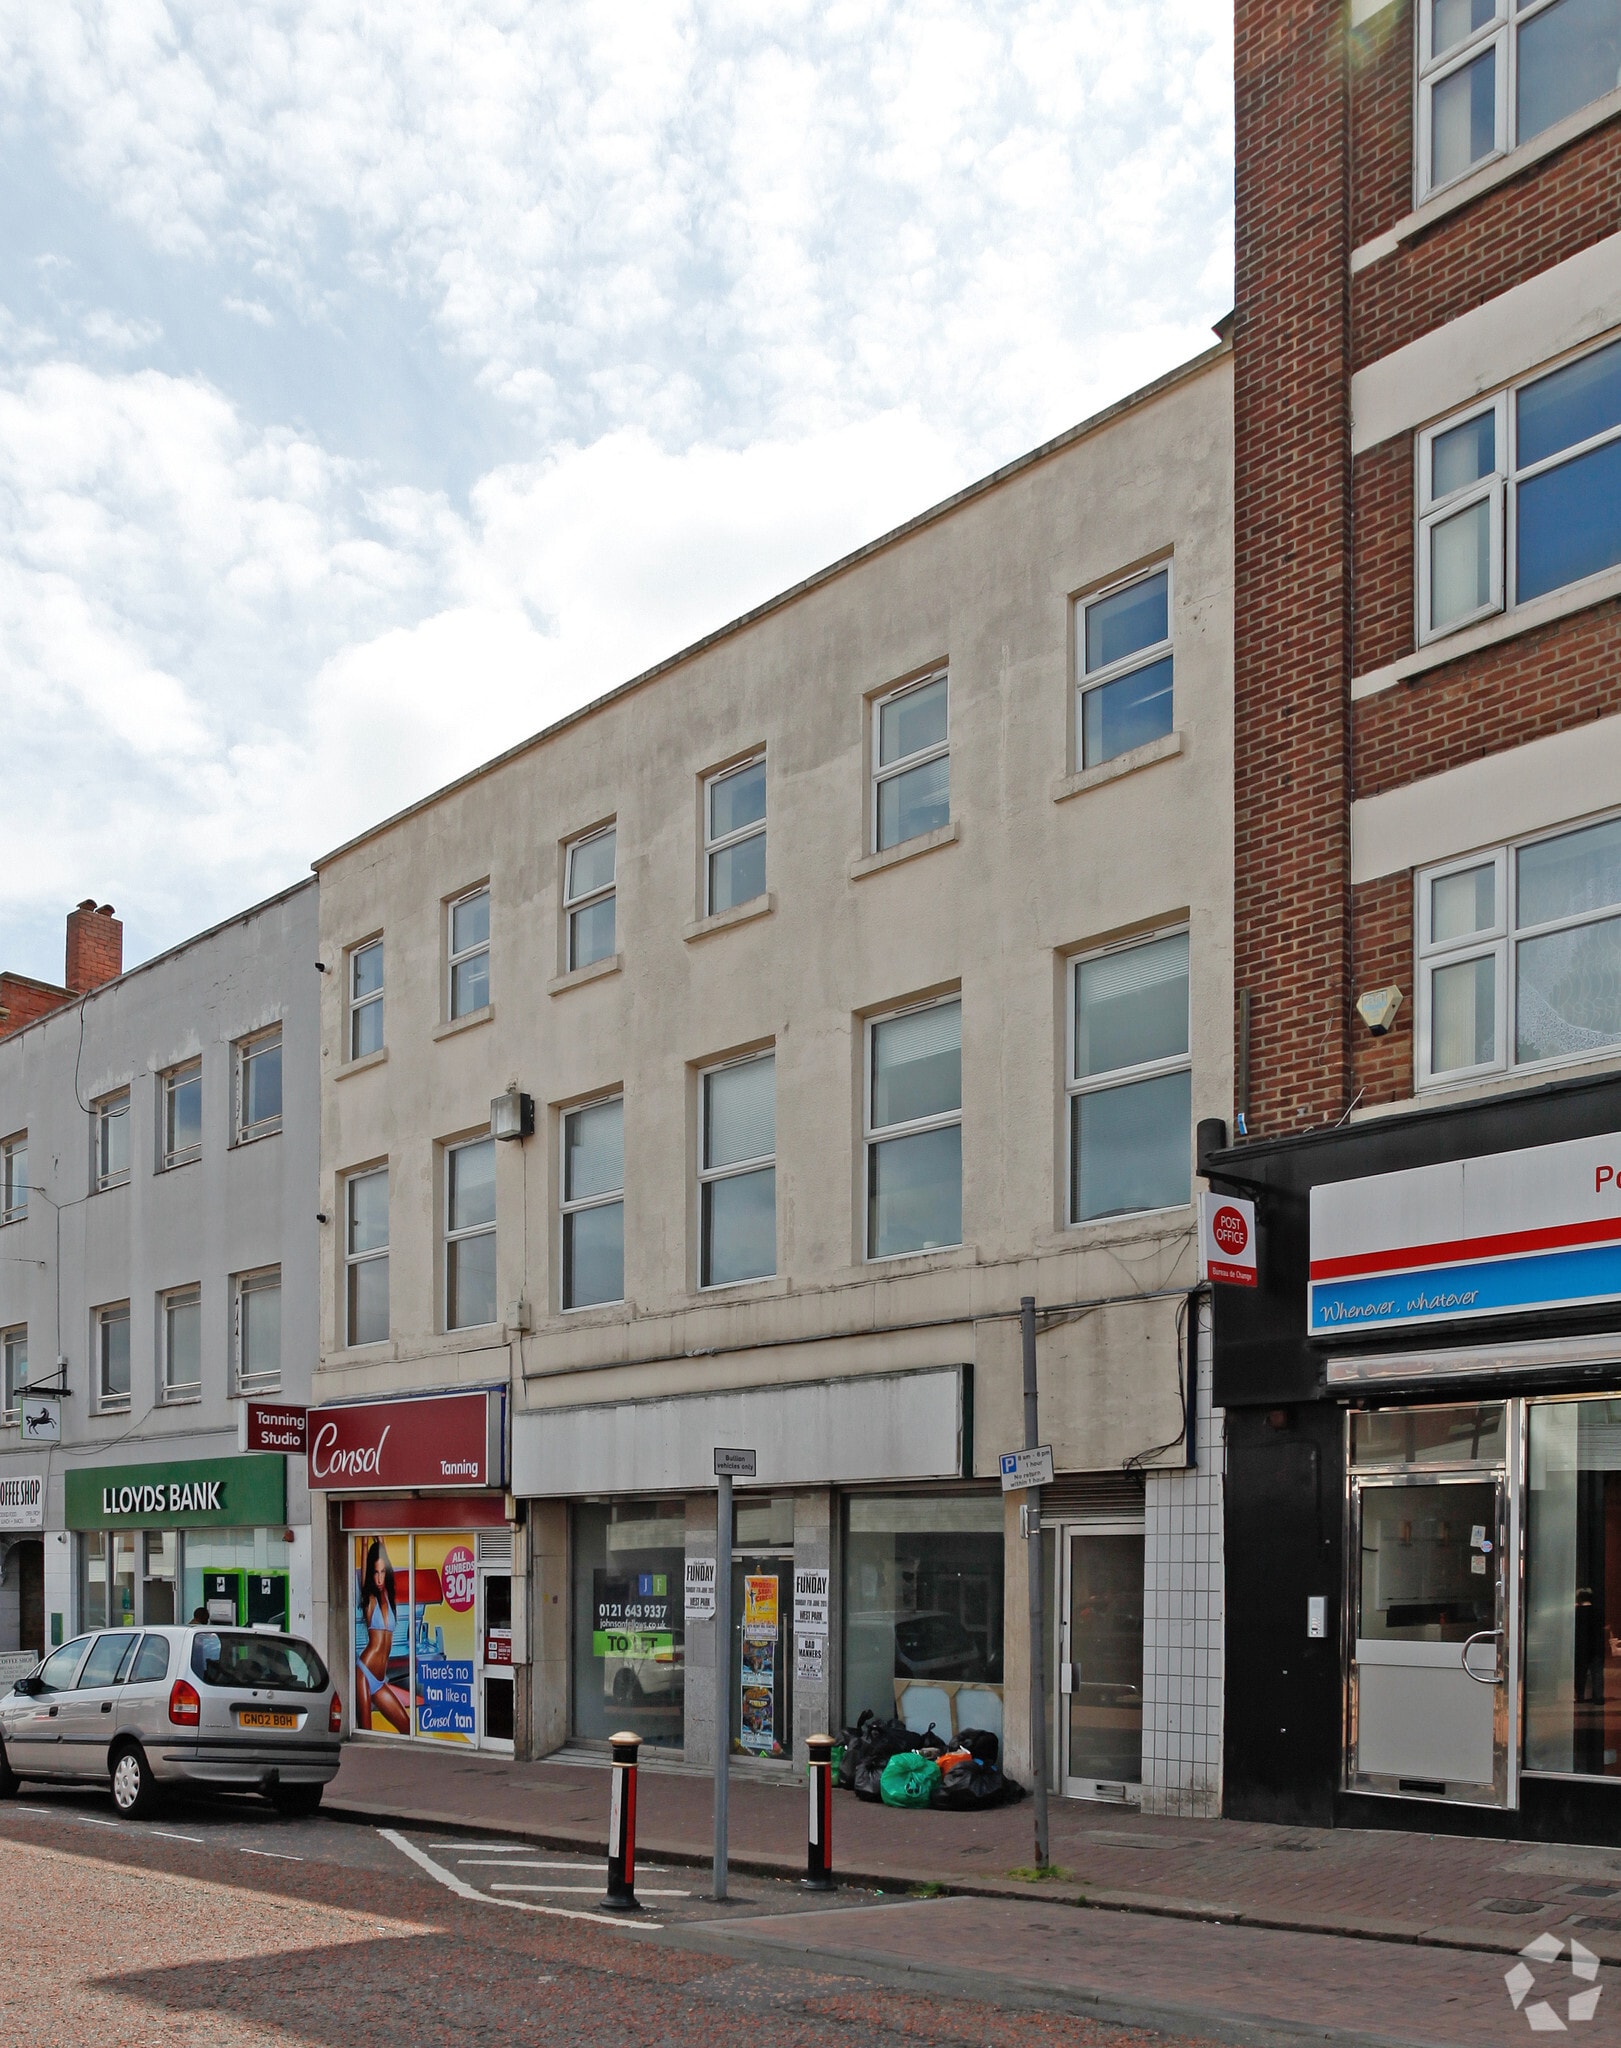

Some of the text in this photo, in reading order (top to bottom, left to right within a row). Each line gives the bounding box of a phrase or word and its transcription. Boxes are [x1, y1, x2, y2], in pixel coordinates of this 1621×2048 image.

[1220, 1215, 1241, 1230] POST
[1216, 1228, 1245, 1245] OFFICE
[1212, 1266, 1252, 1282] Bureau de Change
[1406, 1290, 1479, 1312] whatever
[256, 1411, 305, 1430] Tanning
[261, 1431, 301, 1446] Studio
[312, 1422, 391, 1479] Consol
[725, 1454, 745, 1462] Bullion
[440, 1459, 479, 1478] Tanning
[1010, 1480, 1027, 1488] within
[20, 1479, 41, 1506] SHOP
[103, 1481, 221, 1514] LLOYDS BANK
[452, 1550, 466, 1563] ALL
[444, 1560, 475, 1576] SUNBEDS
[686, 1565, 714, 1581] FUNDAY
[445, 1573, 475, 1603] 30p
[796, 1576, 827, 1594] FUNDAY
[690, 1597, 710, 1606] WEST PARK
[599, 1603, 667, 1618] 0121 643 9337
[800, 1610, 822, 1621] WEST PARK
[607, 1635, 658, 1653] TO LET
[805, 1640, 815, 1649] BAD
[799, 1649, 822, 1659] MANNERS
[421, 1664, 469, 1680] There's no
[426, 1685, 467, 1703] tan like a
[243, 1713, 271, 1725] GN02
[421, 1707, 472, 1730] Consol tan
